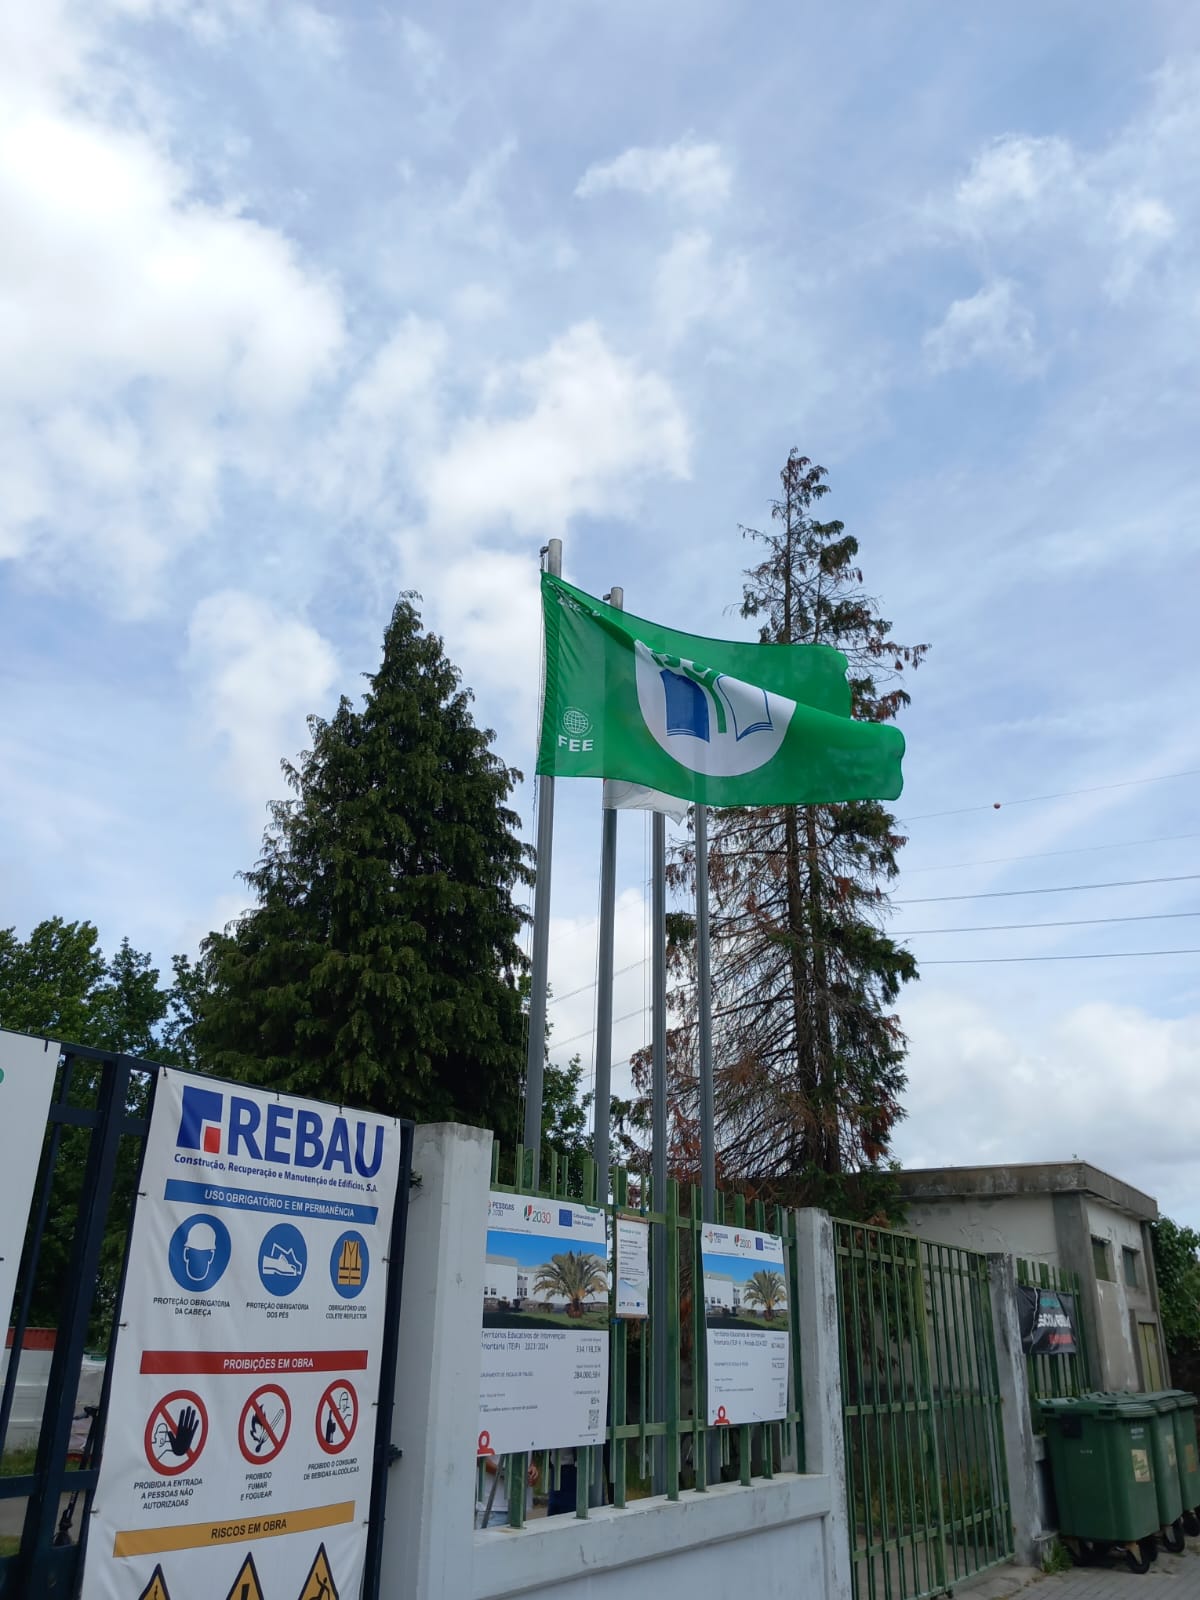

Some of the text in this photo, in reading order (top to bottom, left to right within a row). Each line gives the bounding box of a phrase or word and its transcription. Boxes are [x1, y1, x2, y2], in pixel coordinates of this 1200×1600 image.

[558, 734, 594, 752] FEE
[227, 1096, 384, 1178] REBAU
[174, 1153, 226, 1171] Construção,
[228, 1162, 277, 1179] Recuperação
[284, 1171, 328, 1186] Manutenção
[328, 1178, 337, 1187] de
[365, 1184, 379, 1193] S.A.
[204, 1190, 355, 1217] USO OBRIGATÓRIO E EM PERMANÊNCIA
[532, 1210, 552, 1224] 2030
[153, 1297, 189, 1307] PROTEÇÃO
[246, 1301, 275, 1311] PROTEÇÃO
[183, 1308, 212, 1317] CABEÇA
[266, 1311, 278, 1319] DOS
[325, 1312, 368, 1320] COLETE REFLECTOR
[223, 1358, 314, 1371] PROIBIÇÕES EM OBRA
[307, 1458, 358, 1470] PROIBIDO O CONSUMO
[245, 1471, 272, 1481] PROIBIDO
[303, 1473, 311, 1481] DE
[311, 1471, 332, 1480] BEBIDAS
[133, 1478, 203, 1490] PROIBIDA A ENTRADA
[247, 1481, 268, 1490] FUMAR
[147, 1490, 178, 1499] PESSOAS
[178, 1487, 194, 1497] NÃO
[240, 1490, 273, 1501] E FOGUEAR
[142, 1499, 189, 1510] AUTORIZADAS
[211, 1519, 287, 1539] RISCOS EM OBRA
